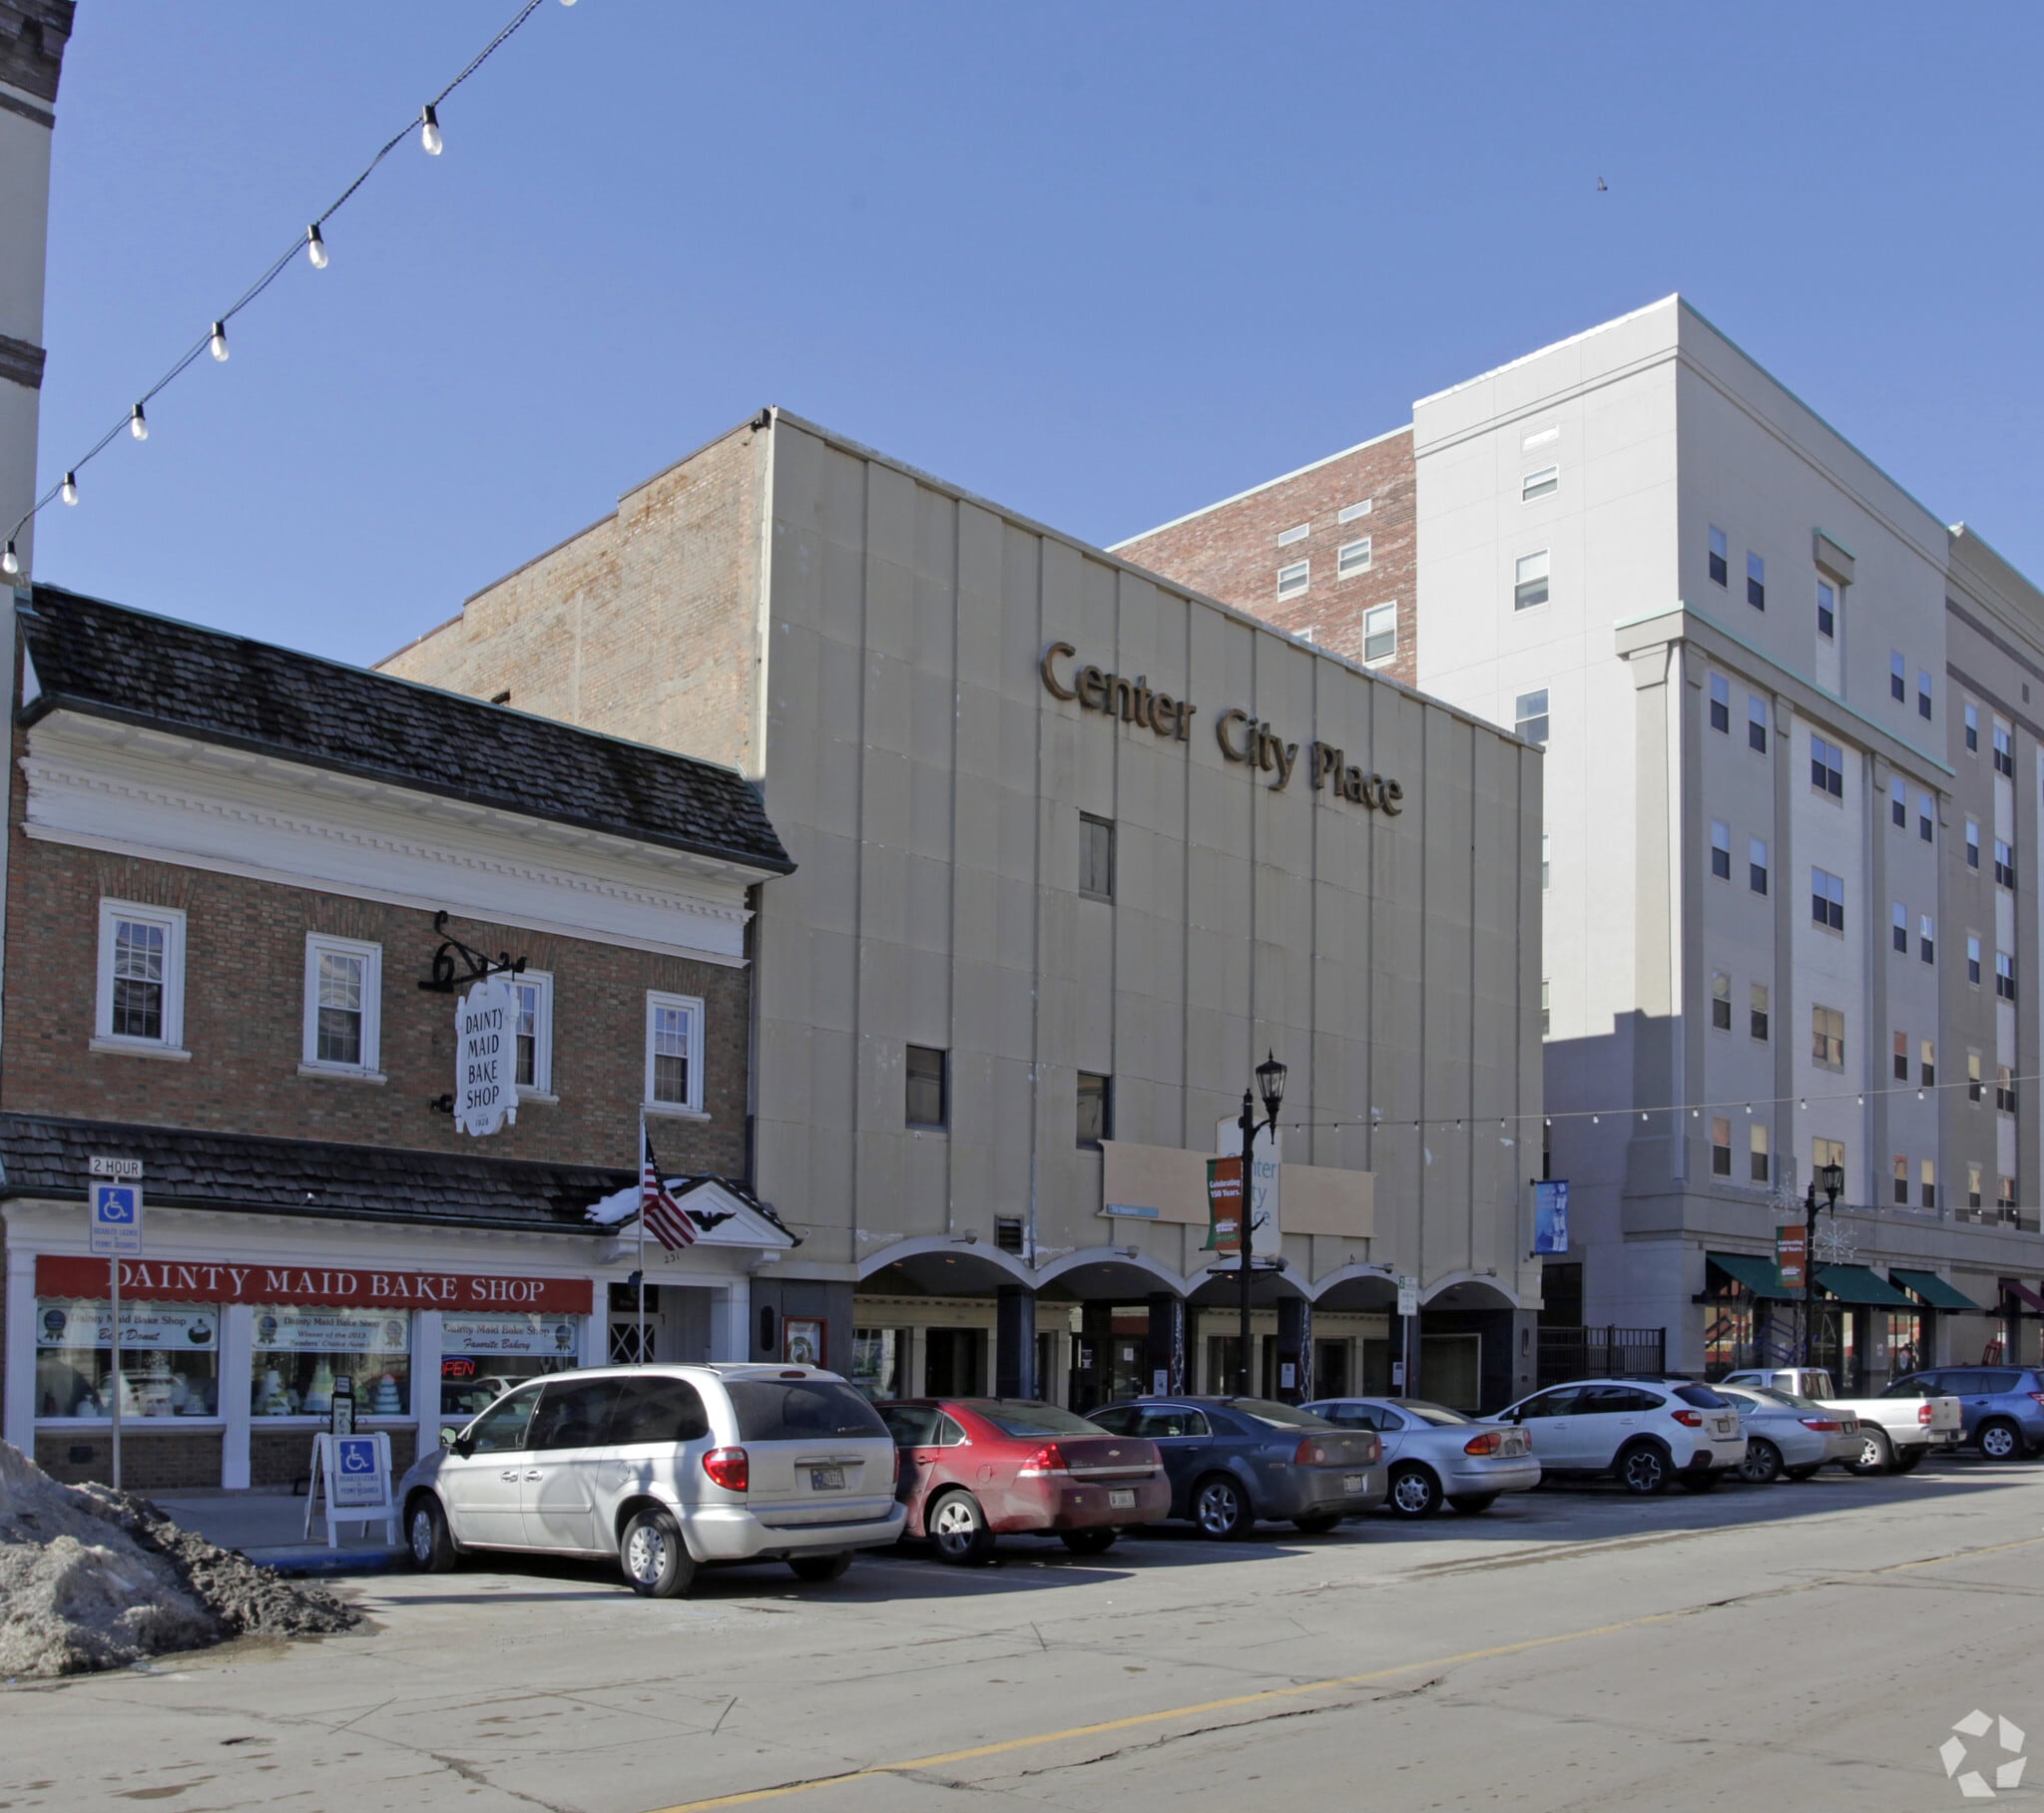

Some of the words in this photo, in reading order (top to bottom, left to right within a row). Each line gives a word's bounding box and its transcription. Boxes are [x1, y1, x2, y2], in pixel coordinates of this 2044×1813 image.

[1038, 642, 1197, 741] Center
[1216, 708, 1298, 791] City
[1310, 740, 1403, 816] Place
[466, 1008, 504, 1035] DAINTY
[468, 1034, 499, 1058] MAID
[469, 1060, 498, 1084] BAKE
[467, 1086, 499, 1110] SHOP
[94, 1159, 101, 1172] 2
[106, 1160, 139, 1175] HOUR
[1209, 1179, 1241, 1188] Celebrating
[107, 1262, 251, 1296] DAINTY
[264, 1270, 357, 1294] MAID
[370, 1274, 458, 1301] BAKE
[471, 1278, 544, 1302] SHOP
[162, 1316, 187, 1327] Shop
[283, 1317, 311, 1327] Dainty
[359, 1319, 380, 1328] Shop
[477, 1325, 499, 1334] Maid
[502, 1325, 524, 1334] Bake
[127, 1329, 161, 1341] Donut
[463, 1338, 498, 1349] Favorite
[501, 1338, 530, 1351] Bakery
